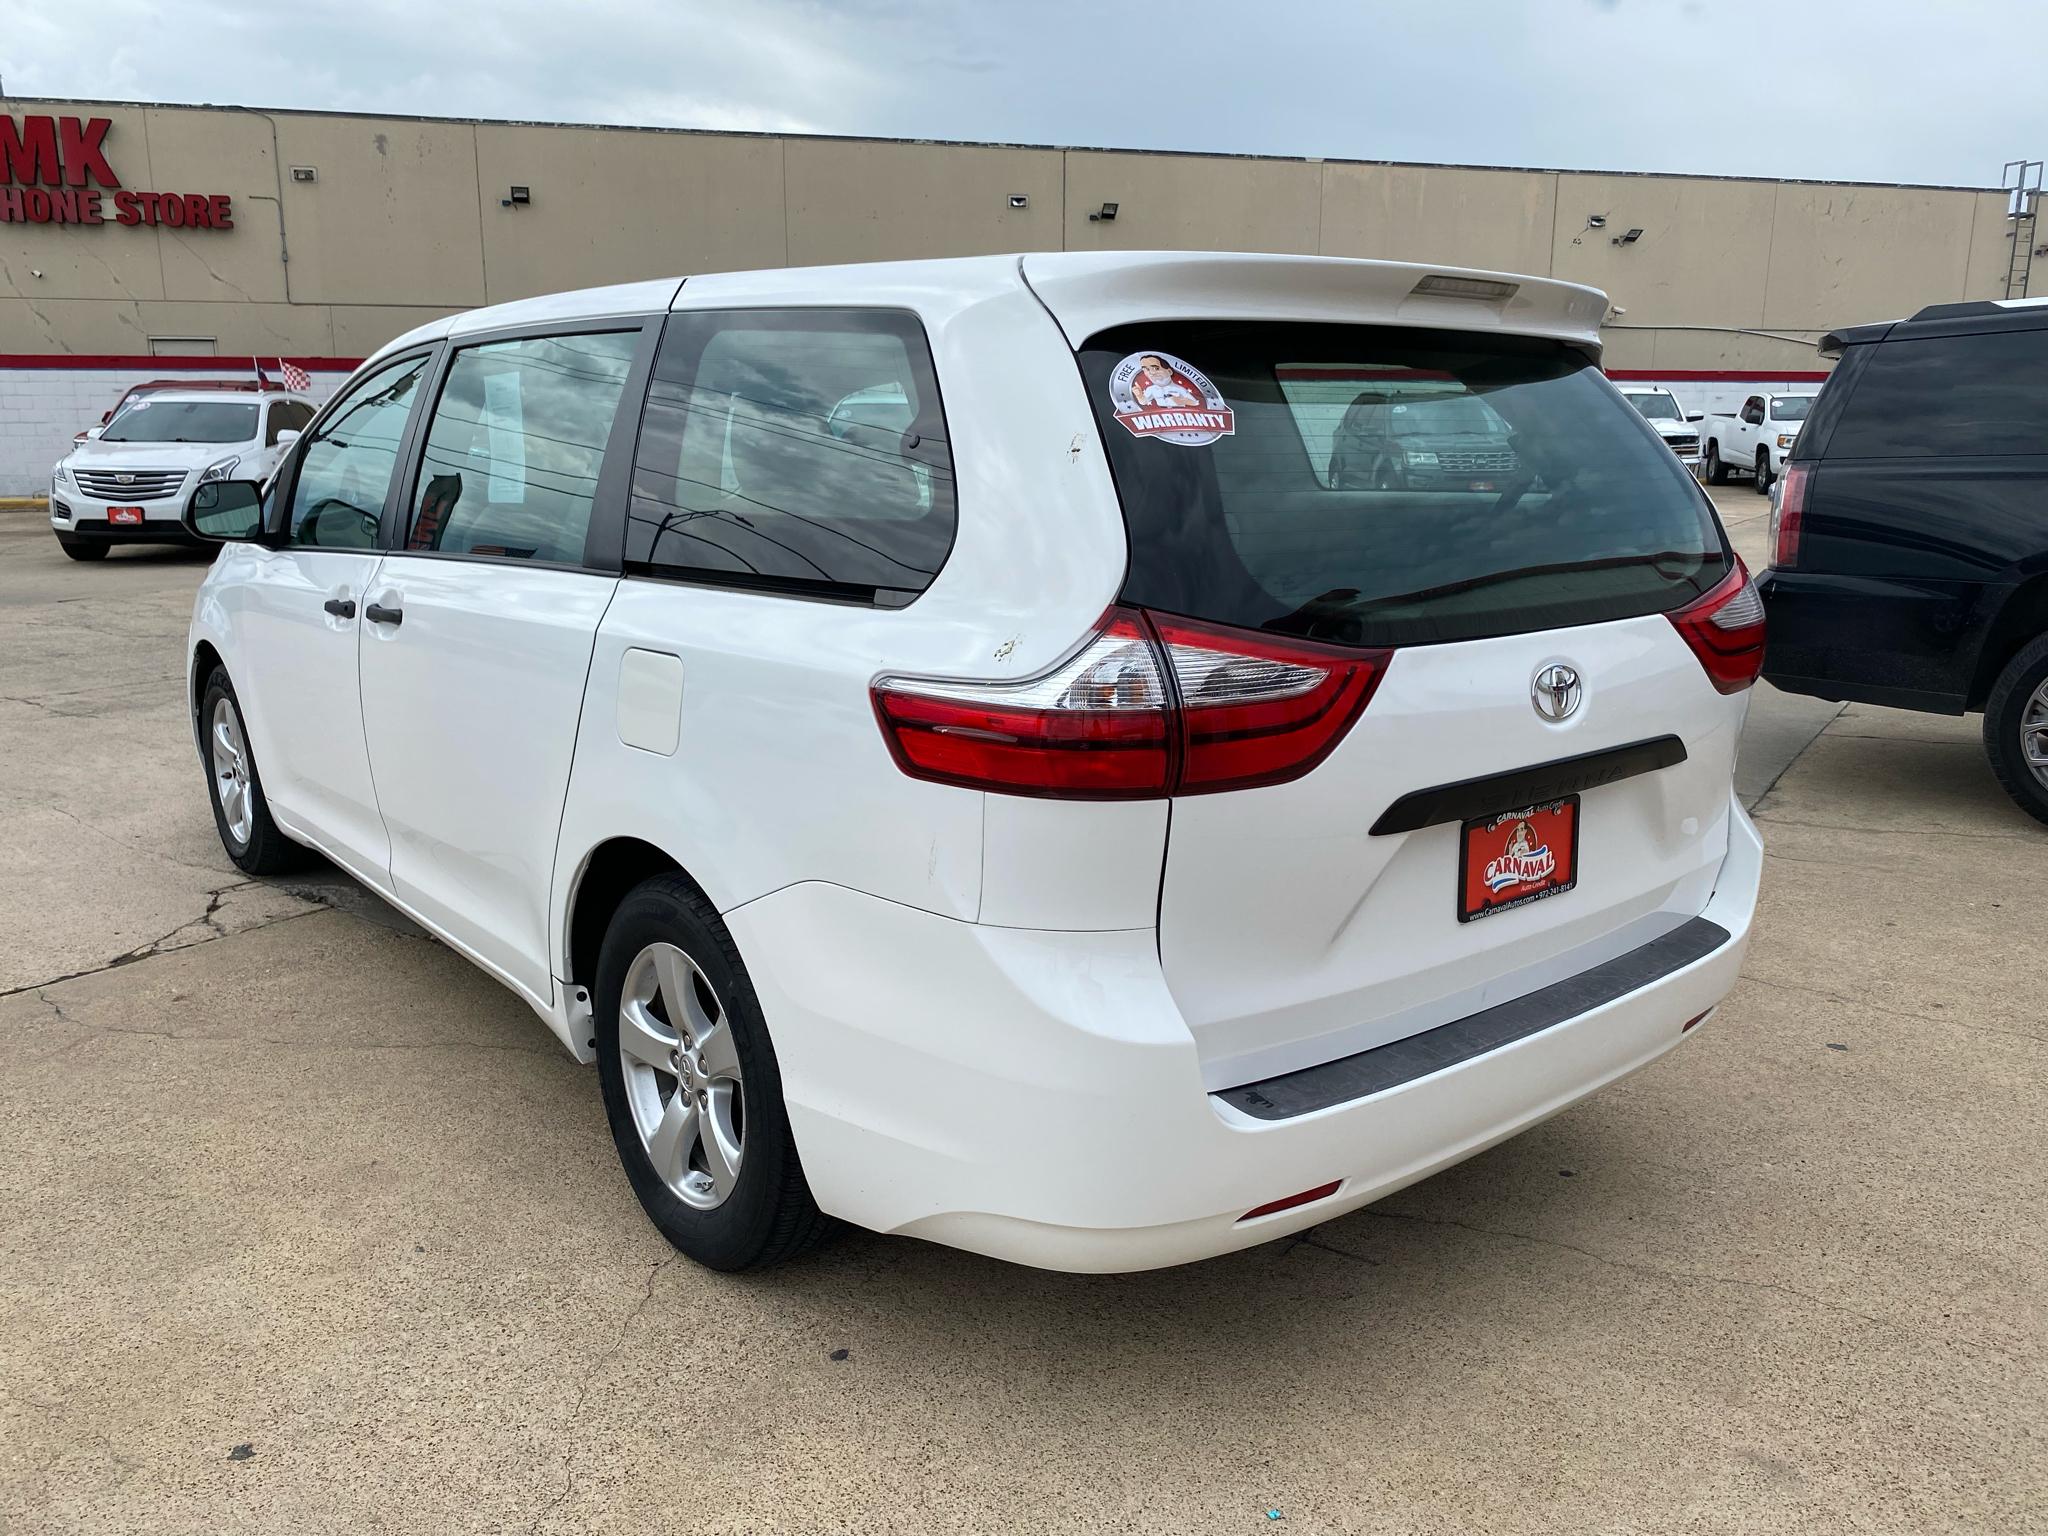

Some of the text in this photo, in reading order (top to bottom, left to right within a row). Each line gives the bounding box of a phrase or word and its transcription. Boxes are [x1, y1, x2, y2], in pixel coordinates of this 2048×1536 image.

[0, 116, 121, 187] MK
[114, 192, 233, 229] STORE
[1117, 361, 1208, 388] FREE LIMITED
[1131, 412, 1226, 430] WARRANTY
[1496, 806, 1535, 825] CARNAVAL
[1484, 850, 1555, 885] CARNAVAL
[1469, 895, 1535, 920] www.CarnavalAutos.com
